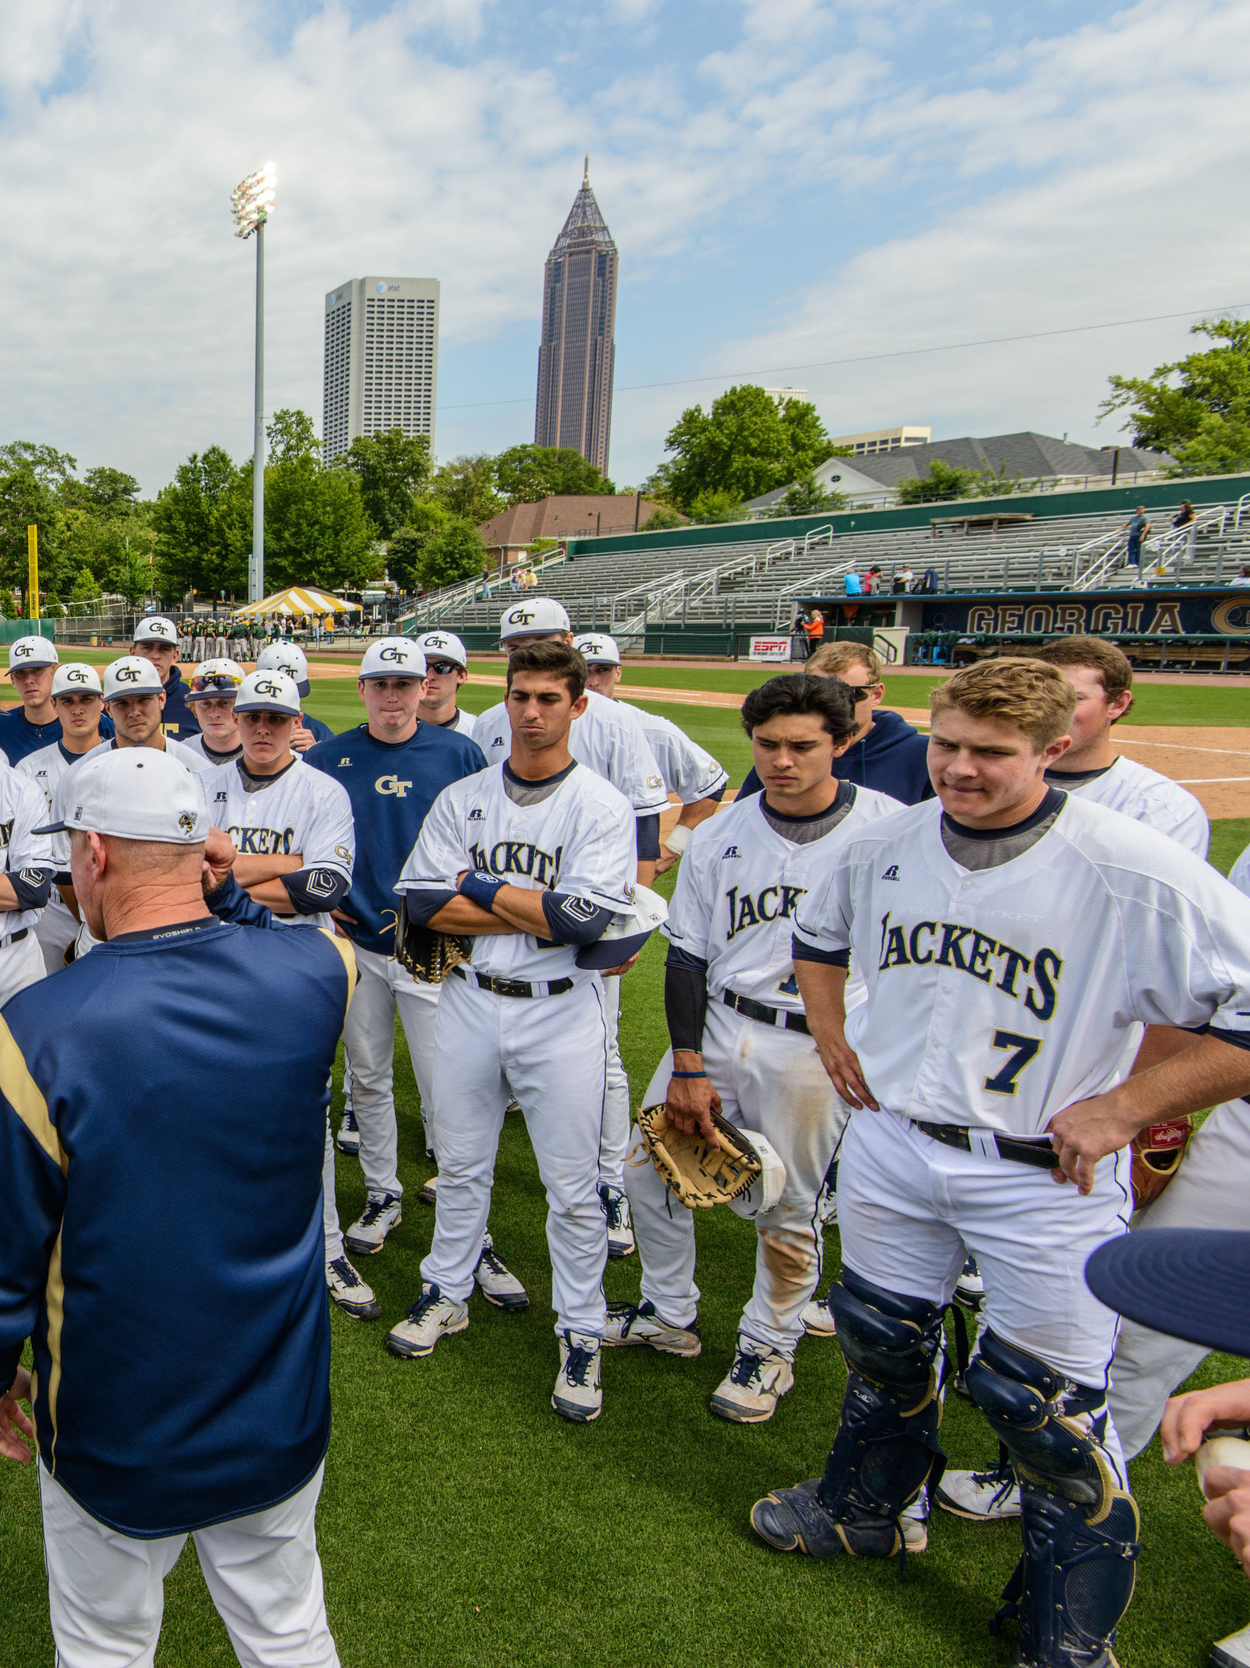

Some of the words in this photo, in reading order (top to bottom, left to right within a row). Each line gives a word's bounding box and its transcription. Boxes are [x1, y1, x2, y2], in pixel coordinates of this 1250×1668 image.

[508, 609, 535, 625] GT
[967, 603, 1184, 636] GEORGIA
[149, 622, 168, 635] GT
[14, 644, 34, 657] GT
[424, 636, 448, 649] GT
[577, 641, 603, 654] GT
[754, 641, 787, 651] ESPN
[380, 647, 408, 664] GT
[67, 669, 89, 683] GT
[115, 666, 141, 682] GT
[277, 664, 298, 680] GT
[254, 680, 282, 698] GT
[374, 774, 413, 798] GT
[878, 910, 1065, 1023] JACKETS
[982, 1028, 1044, 1096] 7
